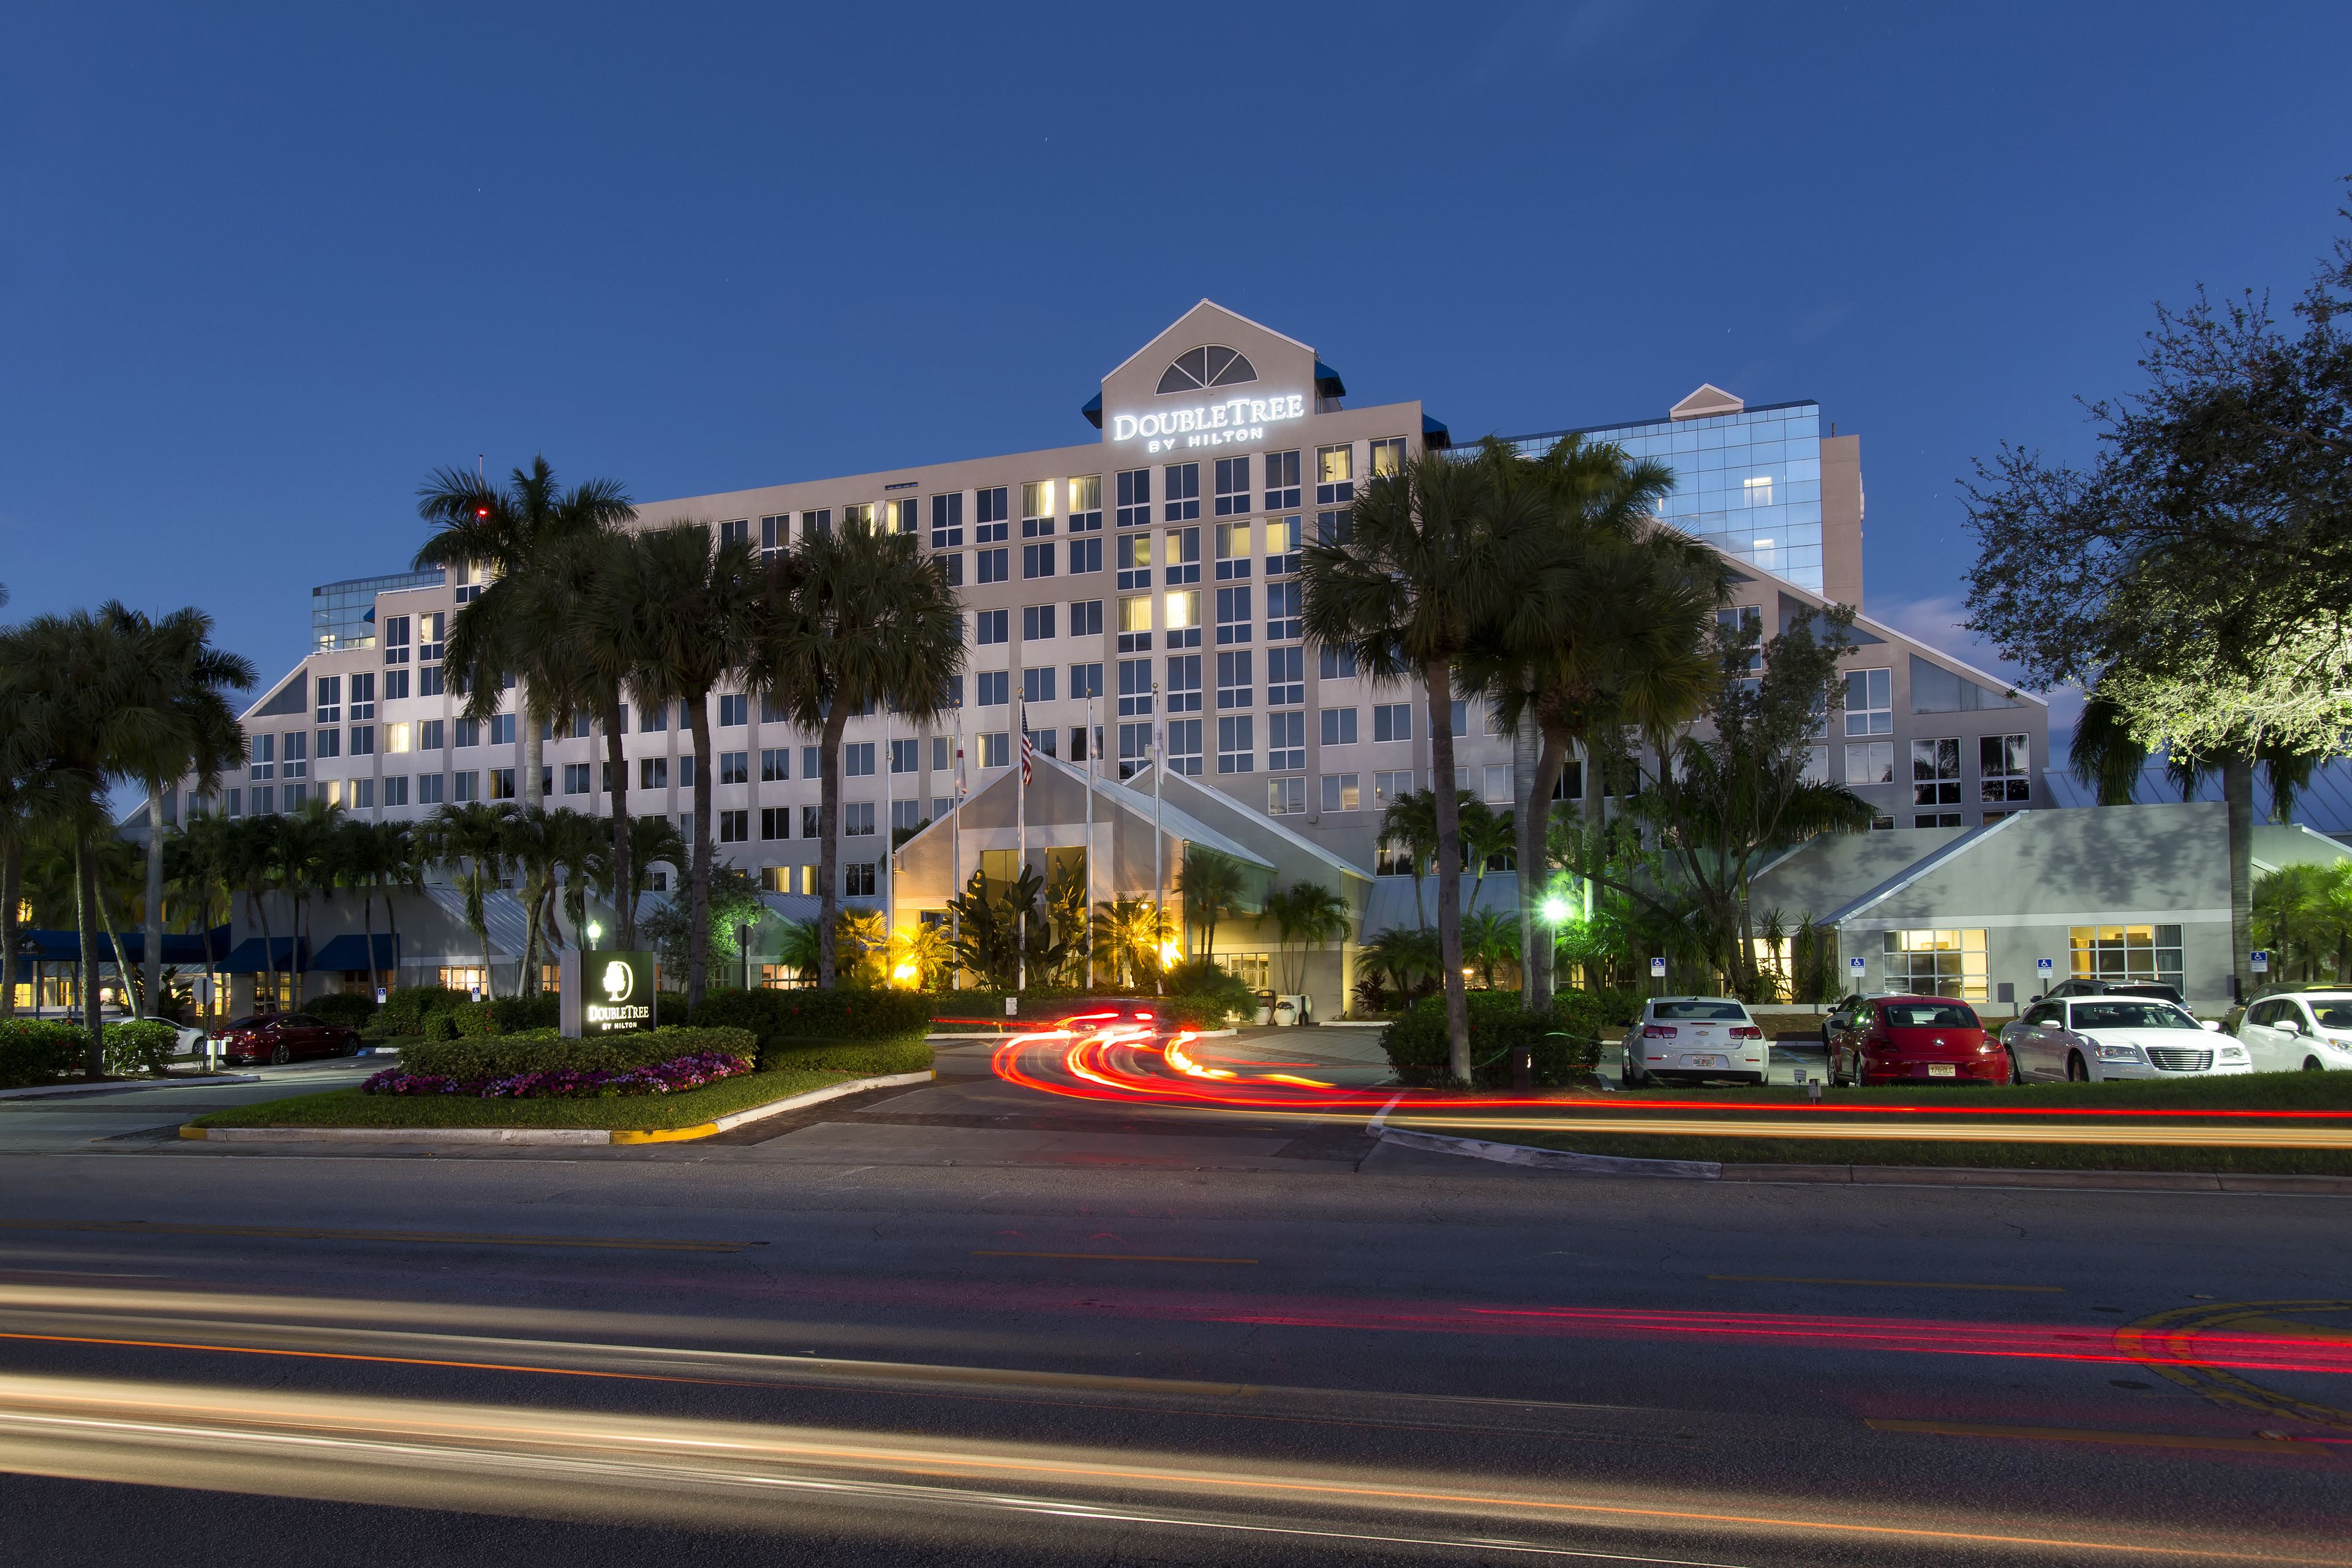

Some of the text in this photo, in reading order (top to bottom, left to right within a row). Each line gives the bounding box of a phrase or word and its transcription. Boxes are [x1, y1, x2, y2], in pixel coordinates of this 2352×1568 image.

[1114, 395, 1304, 441] DOUBLETREE
[1148, 428, 1263, 453] BY HILTON
[589, 1005, 649, 1021] DOUBLETREE
